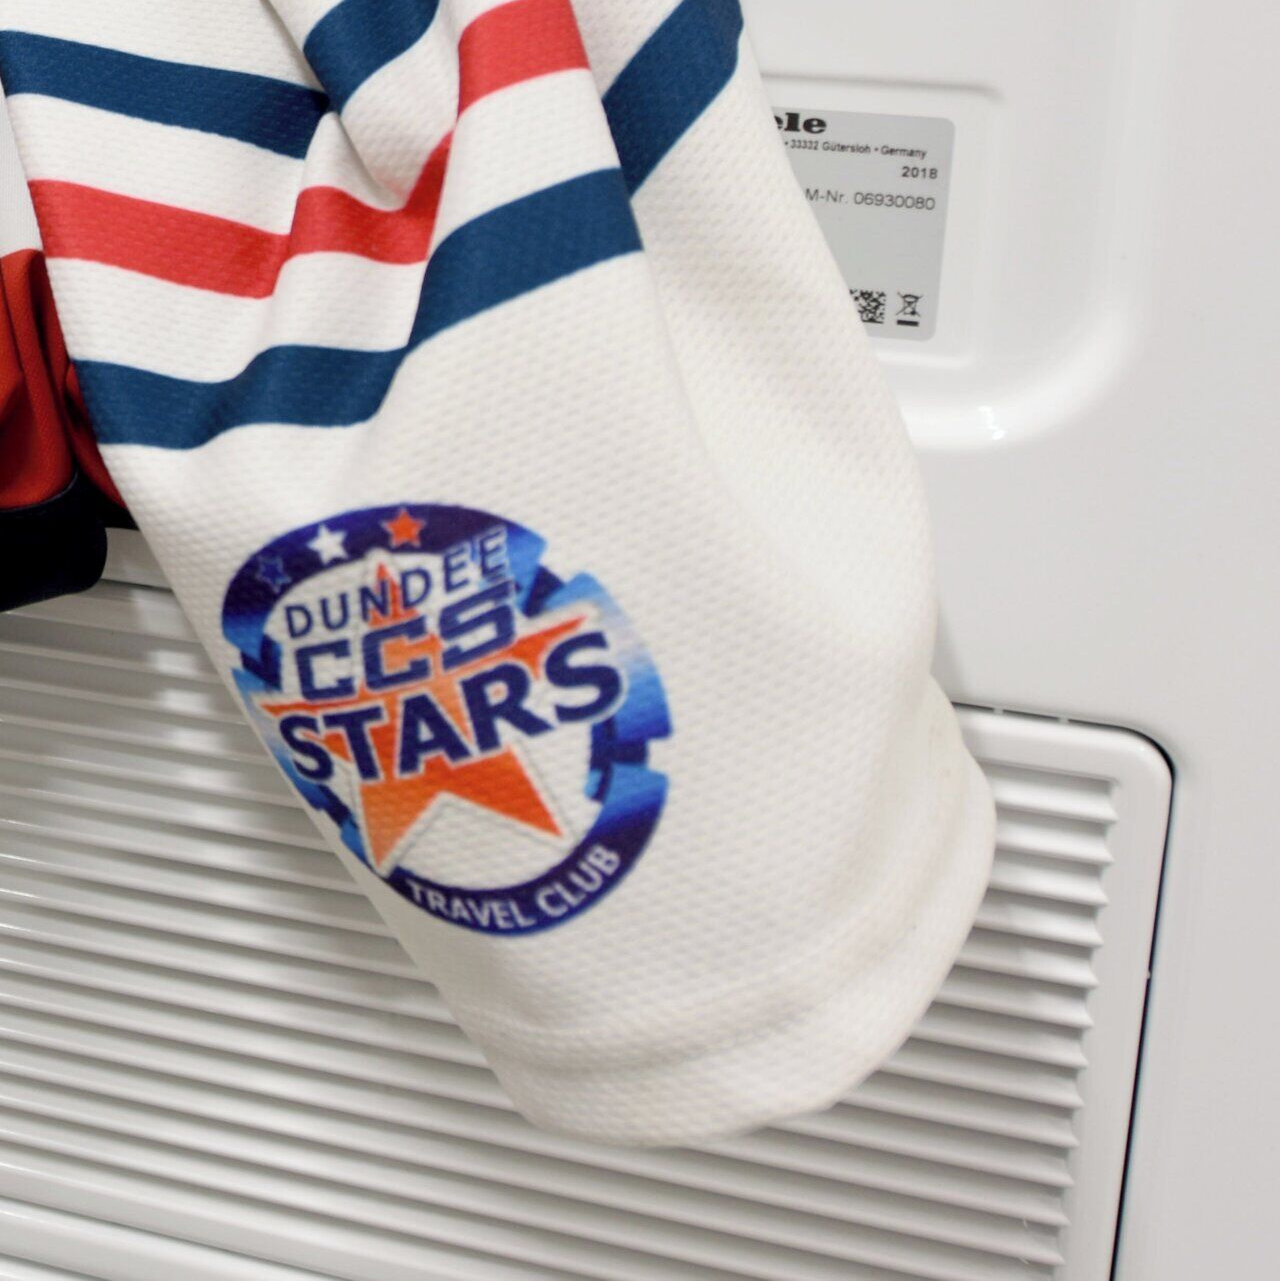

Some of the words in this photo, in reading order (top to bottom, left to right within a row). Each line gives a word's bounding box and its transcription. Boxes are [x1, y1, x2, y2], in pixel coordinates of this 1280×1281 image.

[880, 145, 928, 160] Germany
[901, 165, 939, 180] 2018
[853, 191, 937, 211] 06930080
[284, 524, 510, 639] DUNDEE
[294, 581, 517, 702] CCS
[278, 631, 624, 784] STARS
[406, 878, 538, 932] TRAVEL
[535, 843, 623, 919] CLUB
